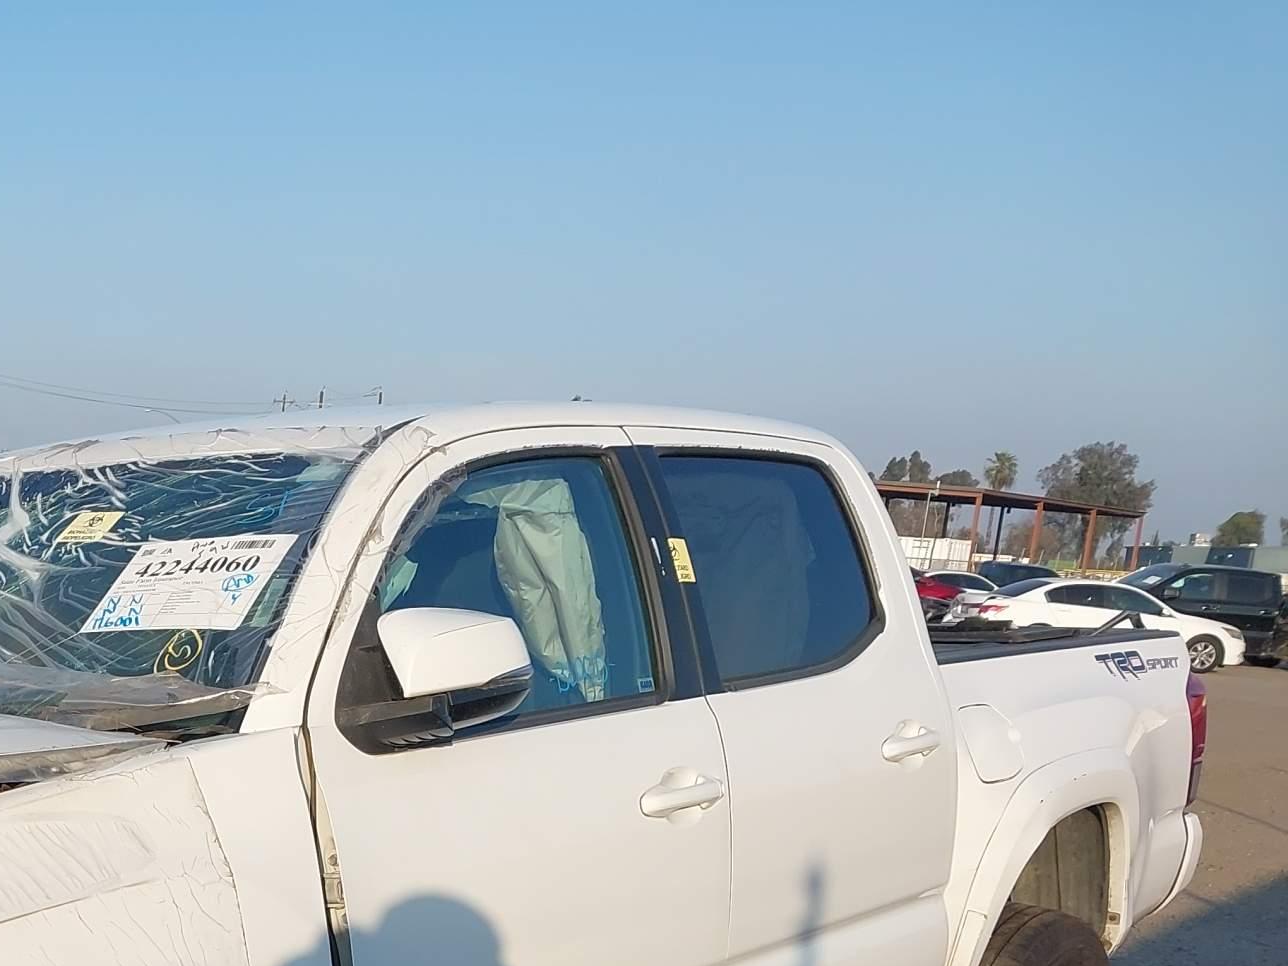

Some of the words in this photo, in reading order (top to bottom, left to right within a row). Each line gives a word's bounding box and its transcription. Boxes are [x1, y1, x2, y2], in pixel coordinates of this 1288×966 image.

[135, 555, 261, 578] 42244060
[1094, 650, 1147, 682] TRD
[1146, 656, 1179, 670] SPORT
